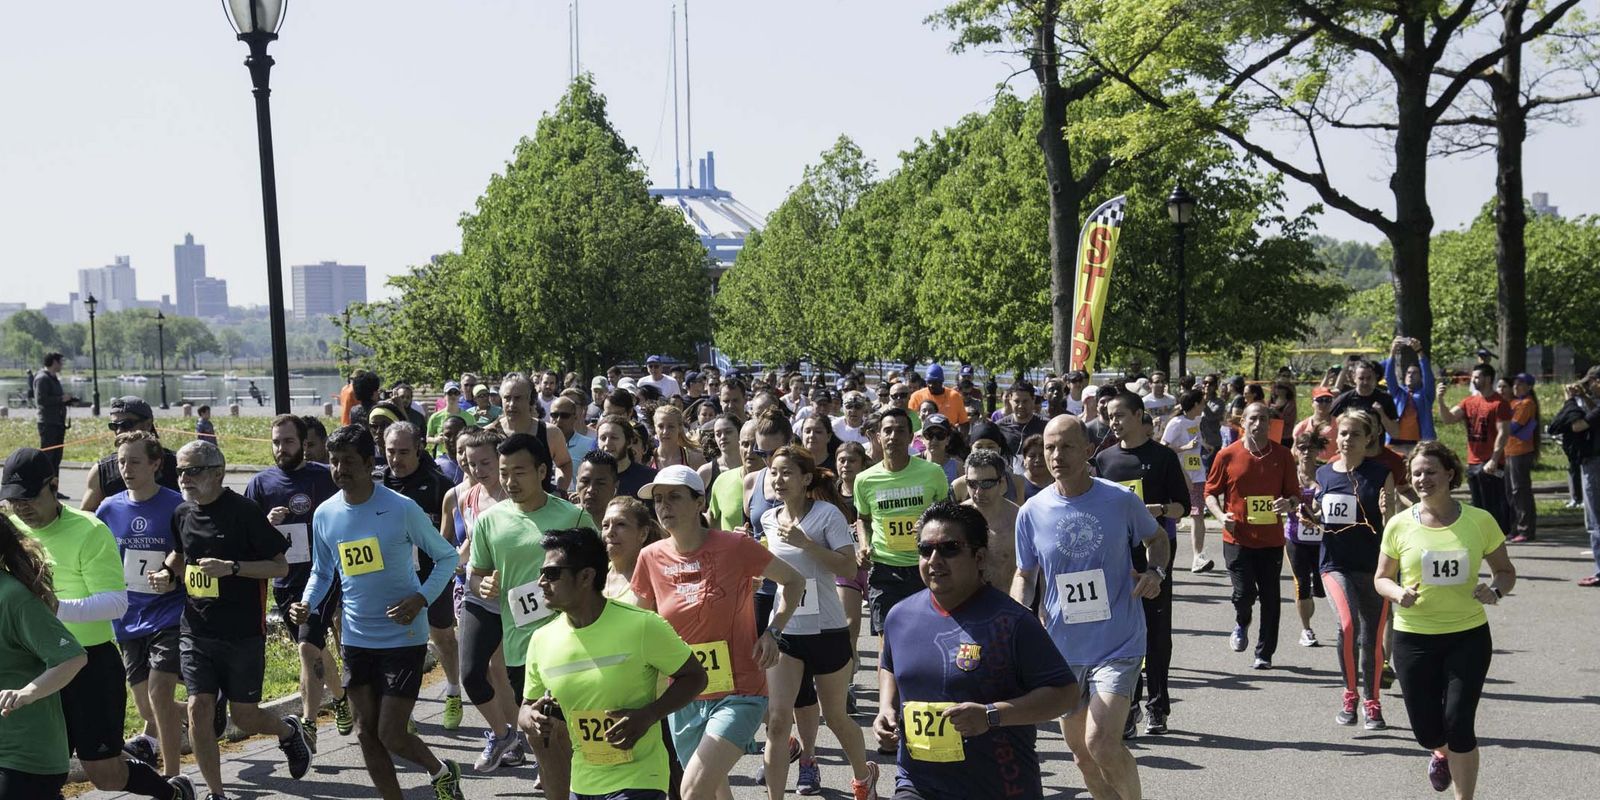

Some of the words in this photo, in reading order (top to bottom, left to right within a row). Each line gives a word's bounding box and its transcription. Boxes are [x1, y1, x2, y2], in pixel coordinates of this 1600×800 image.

[1071, 227, 1111, 371] STAR
[878, 496, 923, 510] NUTRITION
[1328, 502, 1348, 517] 162
[889, 521, 913, 536] 519
[116, 537, 165, 545] BROOKSTONE
[344, 545, 374, 567] 520
[139, 559, 147, 576] 7
[1432, 559, 1459, 577] 143
[189, 571, 212, 589] 800
[1065, 580, 1098, 603] 211
[518, 592, 539, 615] 15
[696, 648, 720, 672] 21
[912, 710, 946, 737] 527
